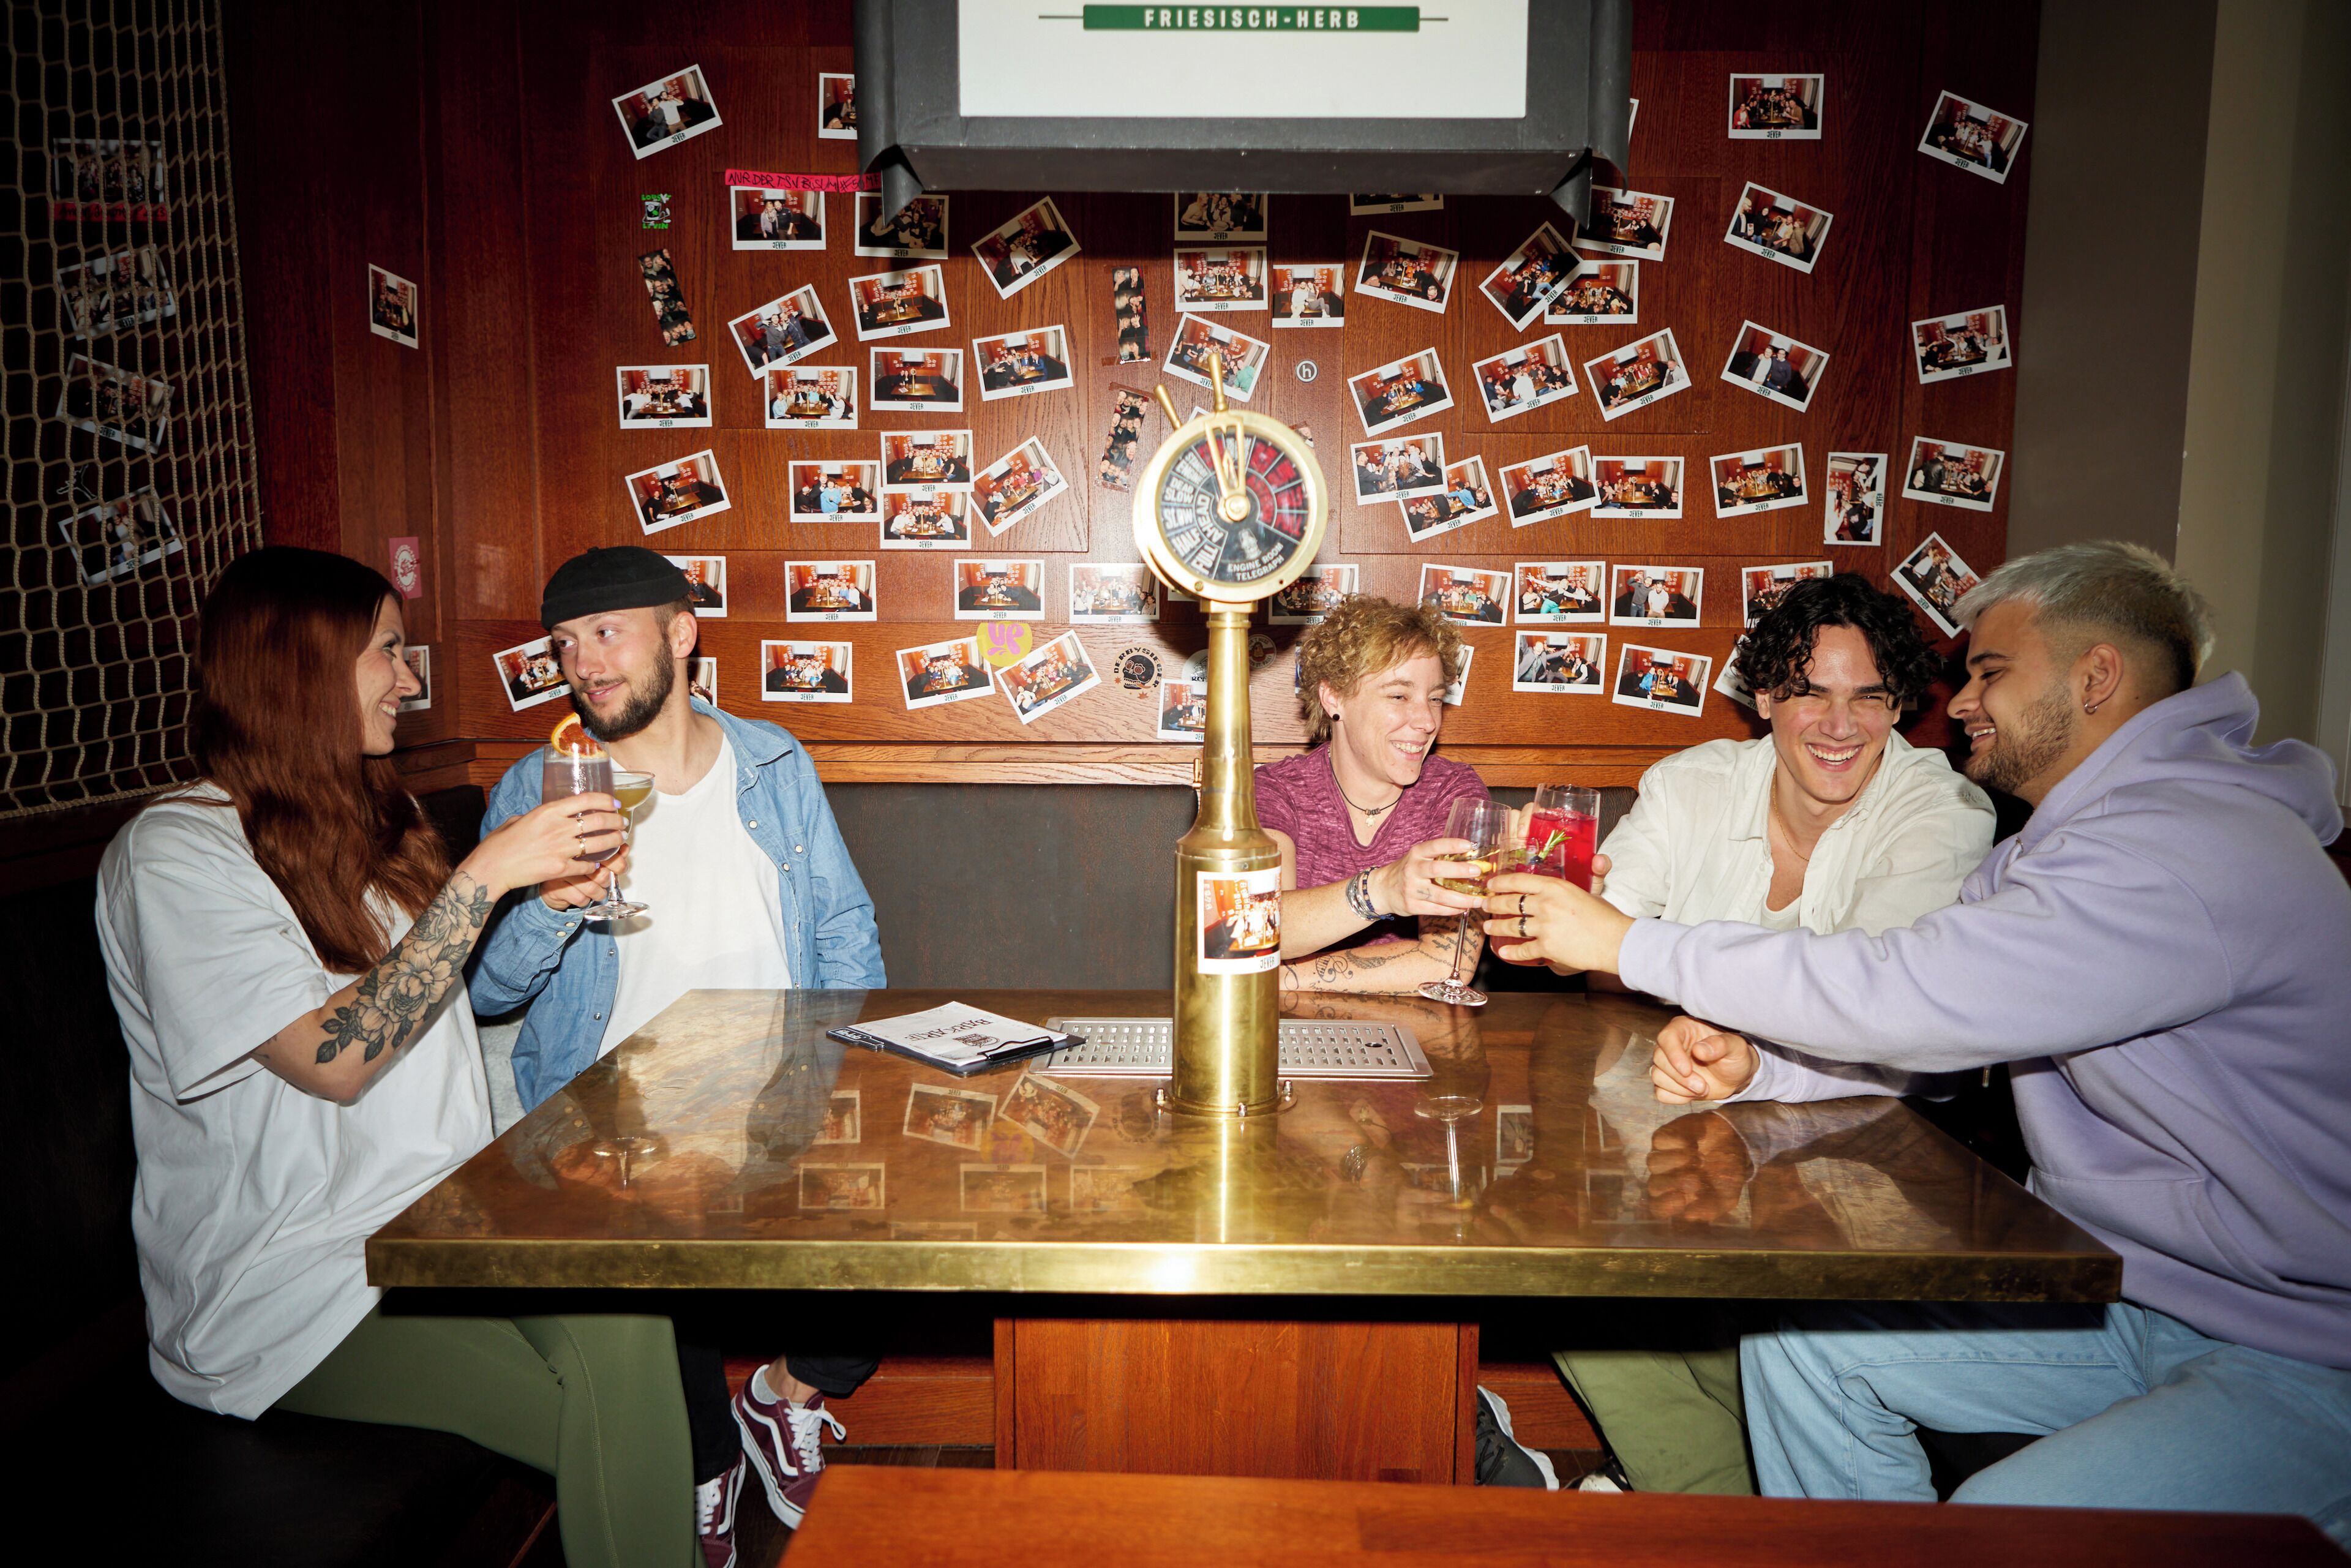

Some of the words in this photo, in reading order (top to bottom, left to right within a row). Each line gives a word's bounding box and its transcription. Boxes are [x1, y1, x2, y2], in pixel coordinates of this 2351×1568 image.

[1144, 10, 1360, 28] FRIESISCH-HERB
[672, 132, 686, 143] JEVER
[1955, 158, 1969, 168] JEVER
[729, 172, 750, 183] NUR
[752, 174, 773, 187] DER
[1610, 245, 1625, 253] JEVER
[1761, 249, 1776, 258] JEVER
[1033, 265, 1048, 277] JEVER
[1393, 294, 1408, 303] JEVER
[1545, 290, 1559, 303] JEVER
[898, 325, 912, 334] JEVER
[788, 351, 801, 362] JEVER
[1958, 367, 1973, 375] JEVER
[1021, 385, 1035, 394] JEVER
[1757, 386, 1771, 397] JEVER
[1527, 399, 1540, 408] JEVER
[1640, 394, 1654, 405] JEVER
[1403, 412, 1416, 422] JEVER
[1164, 489, 1194, 503] SLOW
[1940, 496, 1954, 505] JEVER
[1022, 502, 1036, 515] JEVER
[1755, 502, 1769, 511] JEVER
[680, 512, 694, 522] JEVER
[1549, 508, 1563, 517] JEVER
[1163, 508, 1193, 530] SLOW
[1197, 494, 1224, 543] AHEAD
[1447, 519, 1461, 529] JEVER
[1172, 528, 1201, 557] HALF
[1191, 544, 1219, 575] FULL
[1228, 559, 1262, 572] ENGINE
[1262, 542, 1284, 563] ROOM
[1236, 555, 1284, 581] TELEGRAPH
[1114, 647, 1162, 688] DERBYSIEGER
[548, 689, 561, 698] JEVER
[1054, 694, 1068, 705] JEVER
